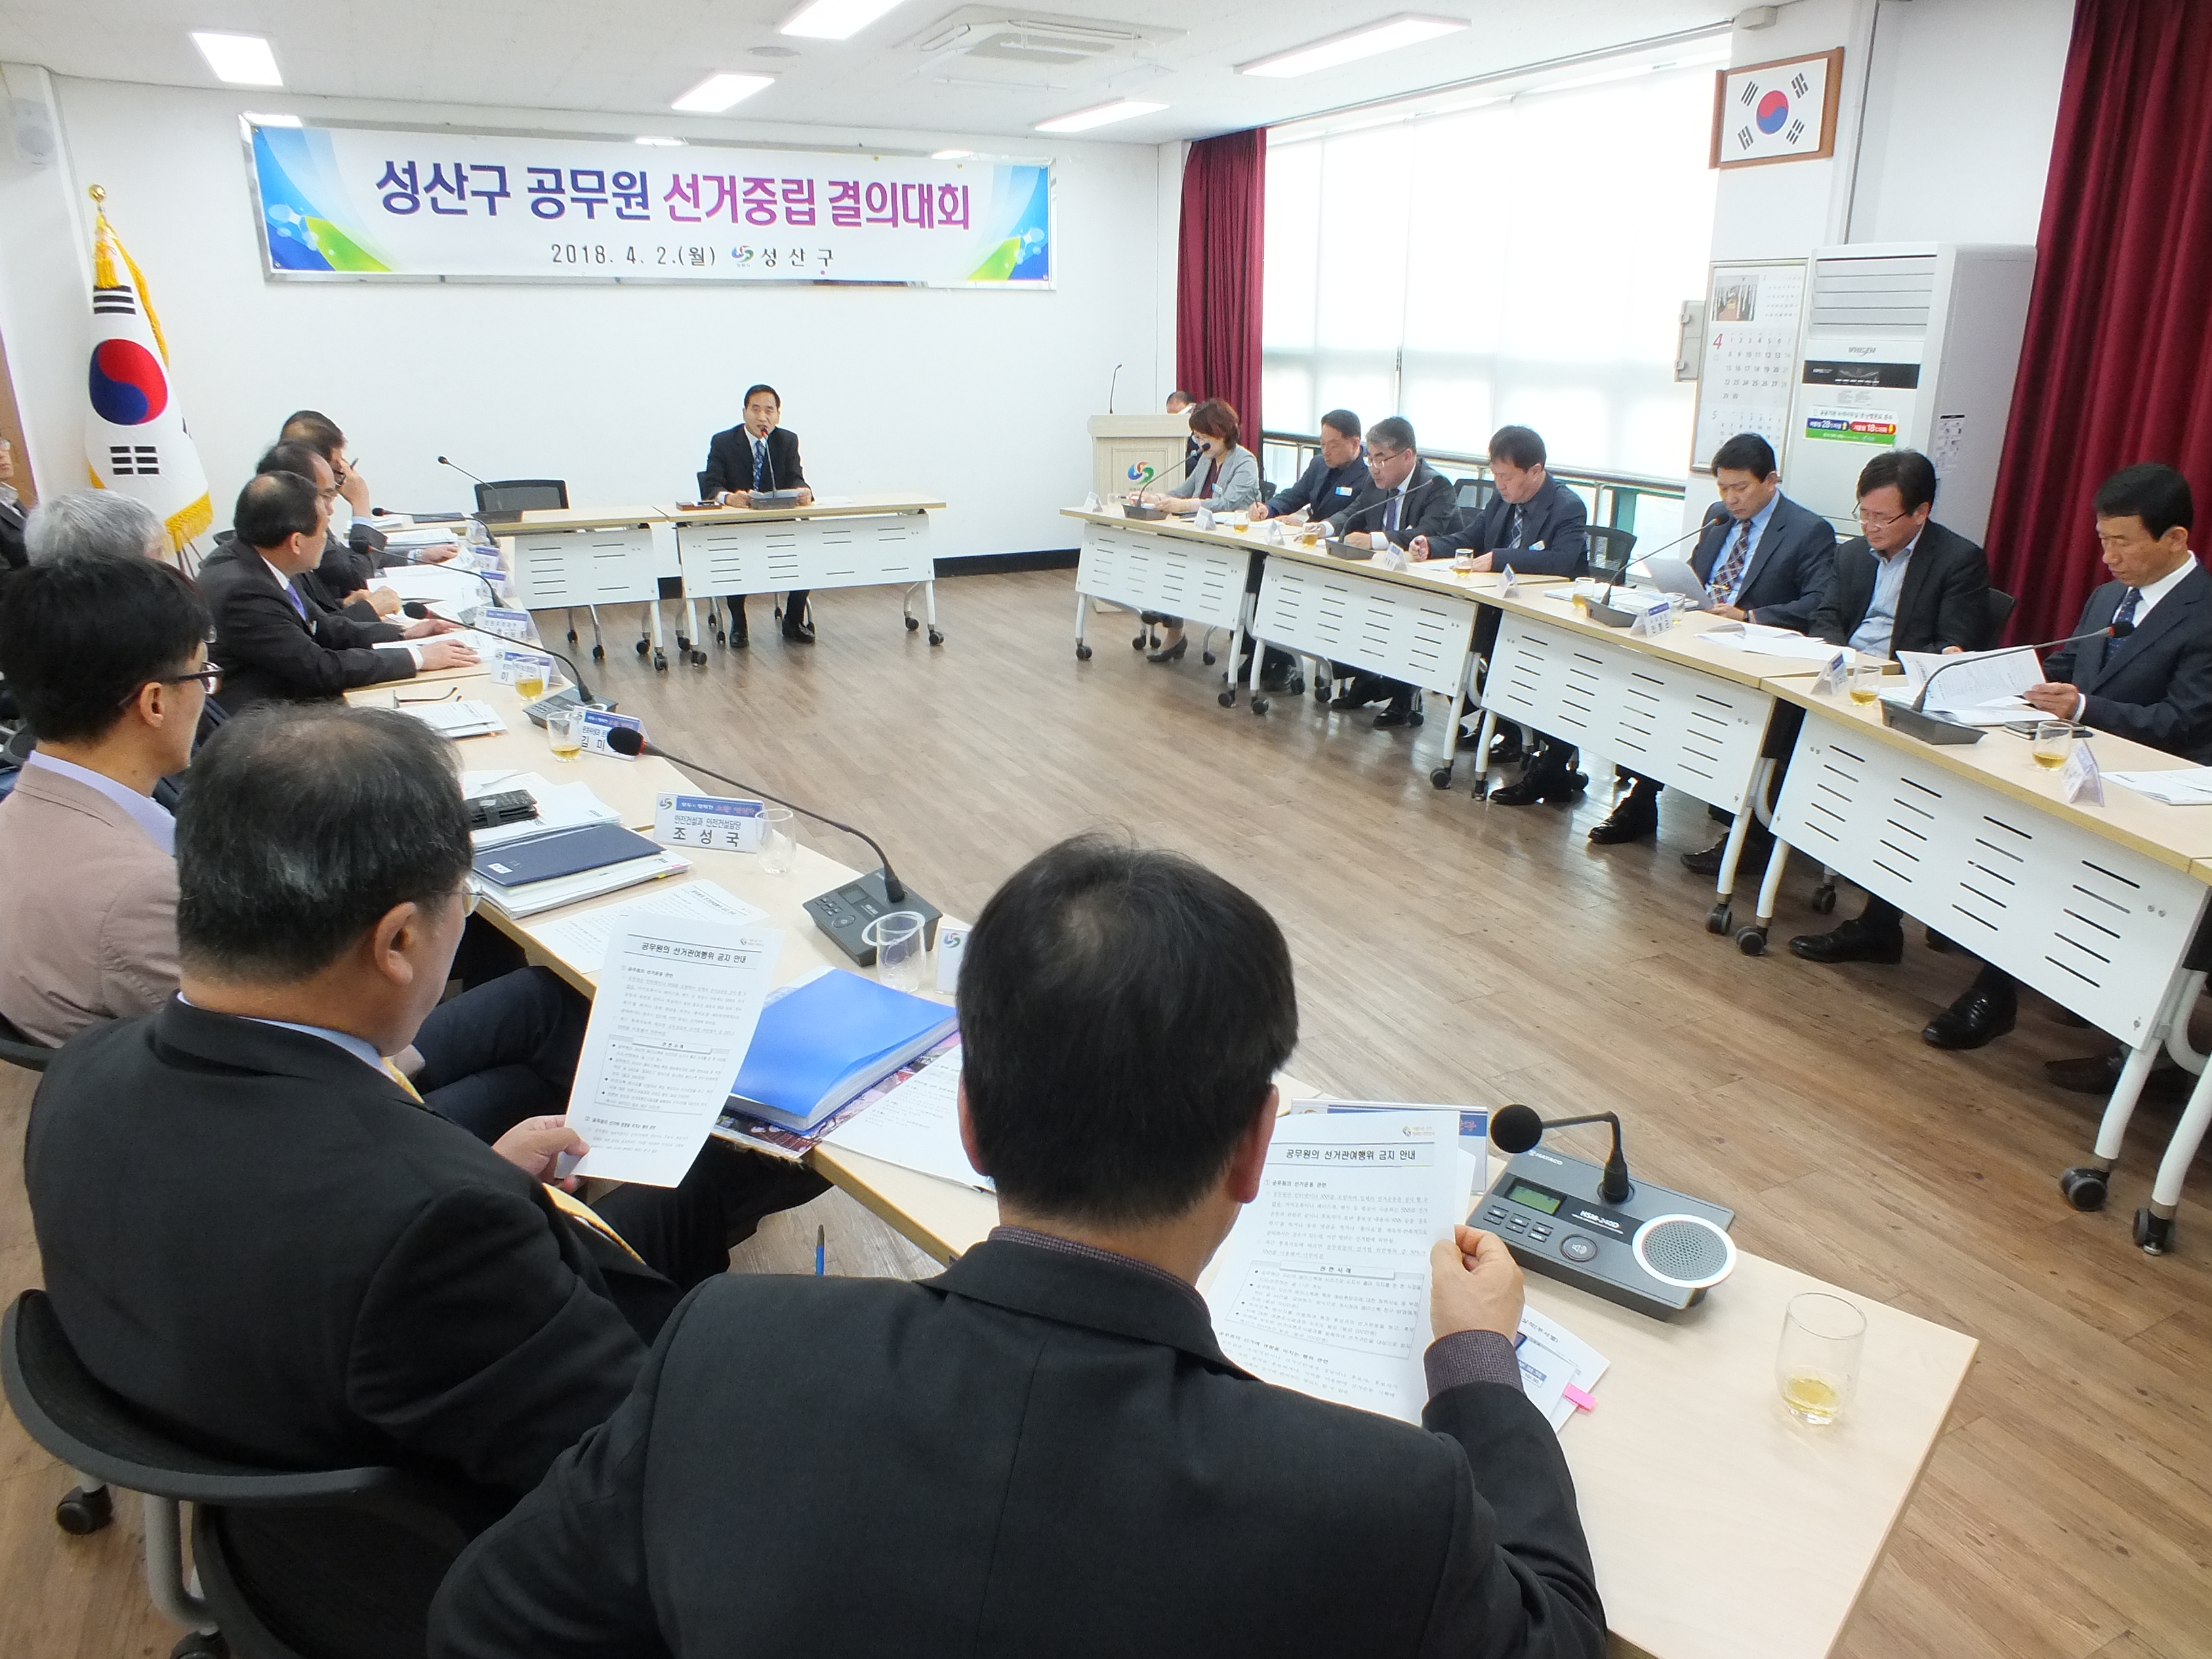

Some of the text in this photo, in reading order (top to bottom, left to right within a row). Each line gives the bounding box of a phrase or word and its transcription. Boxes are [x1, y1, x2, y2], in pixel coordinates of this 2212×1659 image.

[376, 161, 968, 230] 성산구 공무원 선거중립 결의대회
[552, 244, 714, 266] 2018. 4. 2.(월)
[762, 248, 833, 267] 성산구
[1713, 333, 1723, 350] 4
[642, 942, 670, 954] 공무원의
[734, 955, 747, 964] 안내
[1286, 1149, 1416, 1160] 공무원의 선거관여행위 금지 안내
